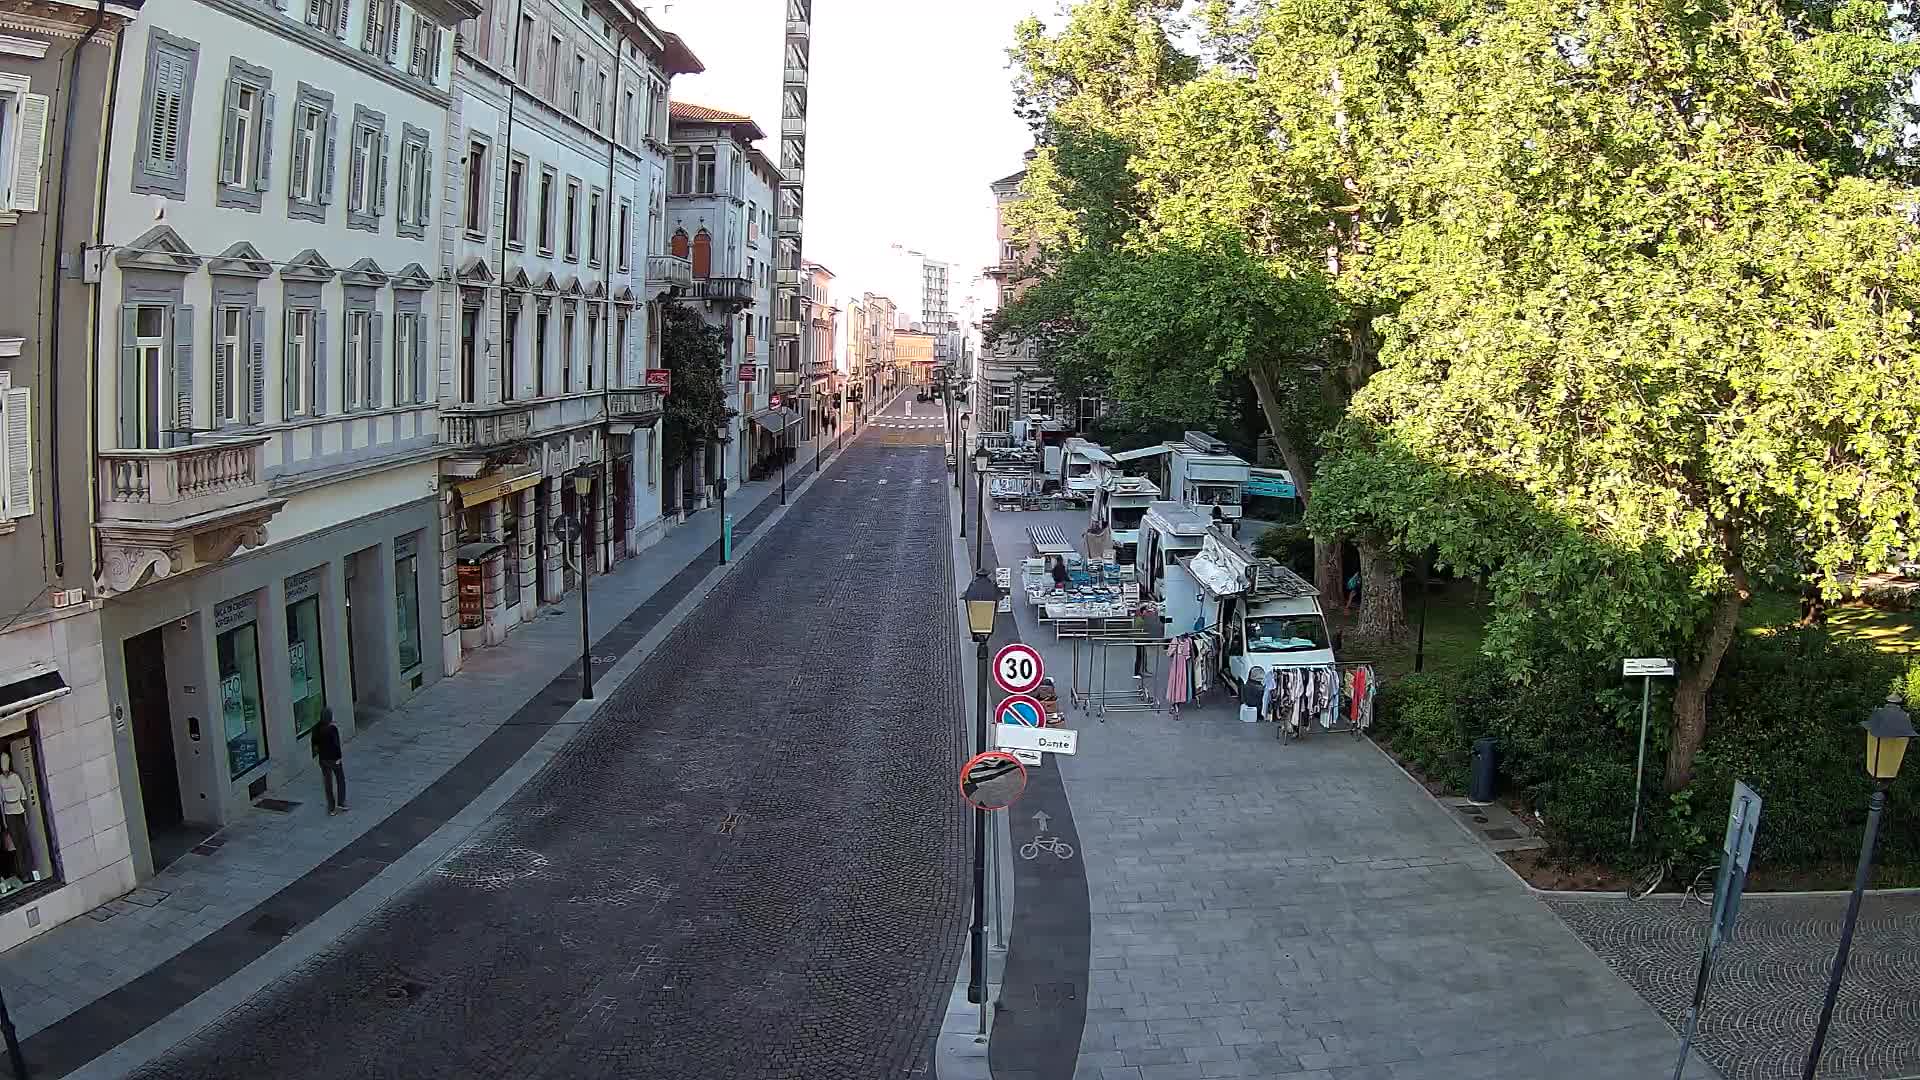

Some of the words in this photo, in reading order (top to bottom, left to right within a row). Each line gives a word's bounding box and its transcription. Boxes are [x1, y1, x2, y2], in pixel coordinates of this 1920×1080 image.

[1005, 658, 1033, 680] 30
[223, 677, 241, 700] 130
[1038, 738, 1070, 749] Dante
